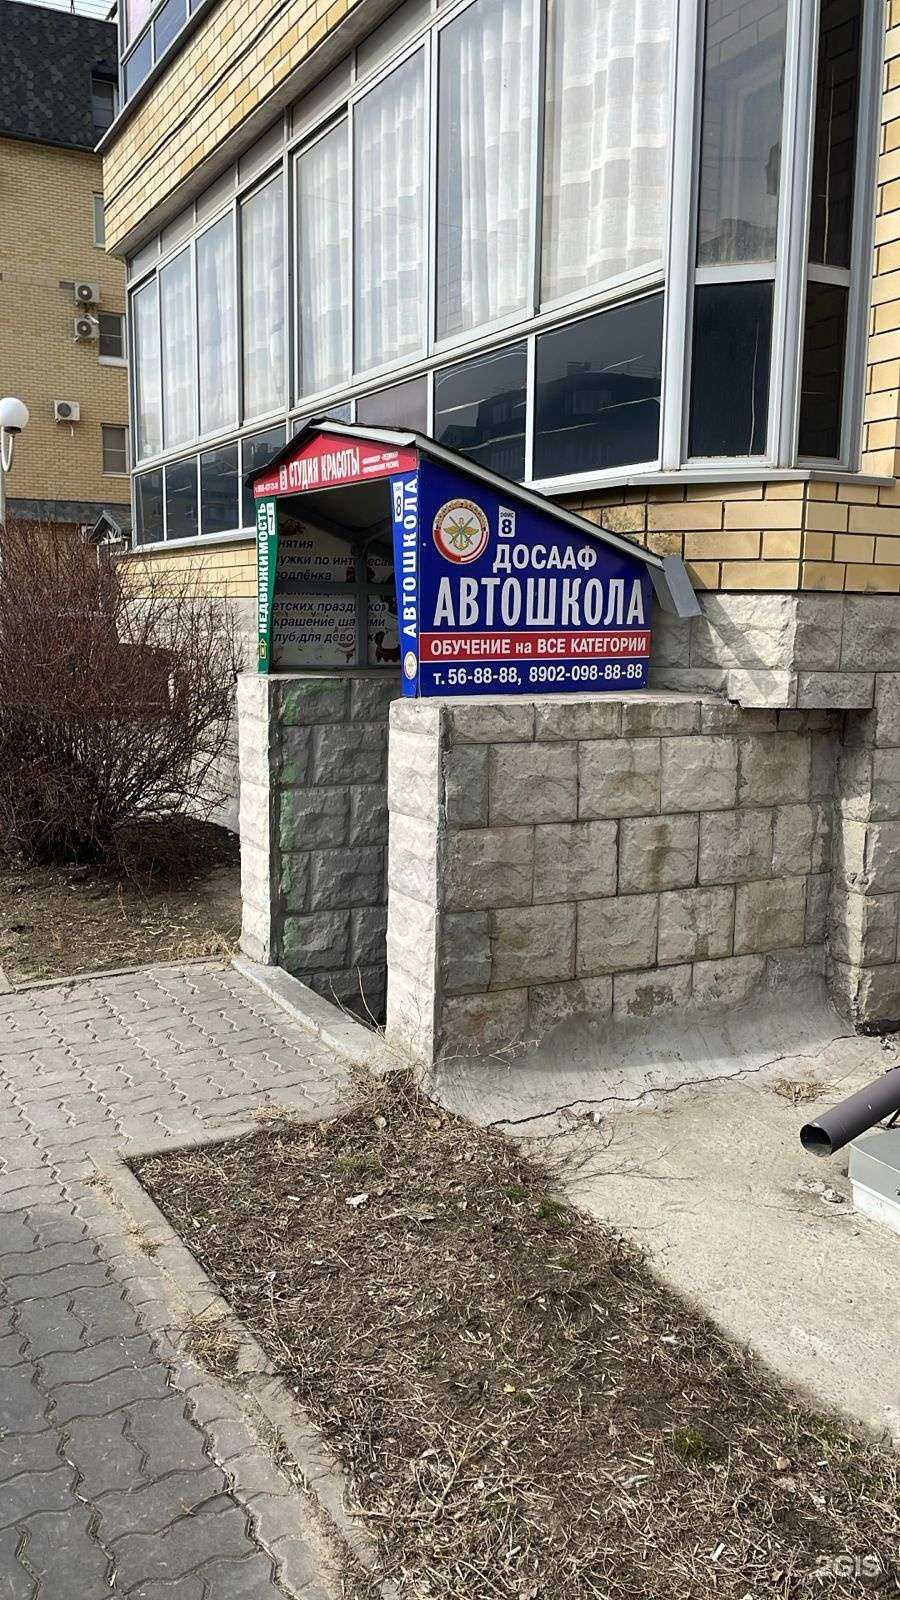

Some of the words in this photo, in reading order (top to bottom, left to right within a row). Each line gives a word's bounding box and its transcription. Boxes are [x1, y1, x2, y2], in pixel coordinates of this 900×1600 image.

[289, 457, 319, 490] СТУДИЯ
[321, 447, 360, 482] КРАСОТЫ
[501, 518, 513, 535] 8
[279, 556, 312, 567] ужки
[314, 557, 330, 566] по
[402, 478, 418, 638] АВТОШКОЛА
[493, 543, 598, 573] ДОСААФ
[257, 503, 270, 633] НЕДВИЖИМОСТЬ
[273, 602, 314, 611] етских
[432, 576, 646, 627] АВТОШКОЛА
[273, 619, 335, 629] крашение
[273, 632, 297, 644] луб
[430, 639, 511, 656] ОБУЧЕНИЕ
[515, 643, 532, 655] на
[537, 638, 566, 654] ВСЕ
[570, 637, 647, 653] КАТЕГОРИИ
[528, 663, 643, 682] 8902-098-88-88
